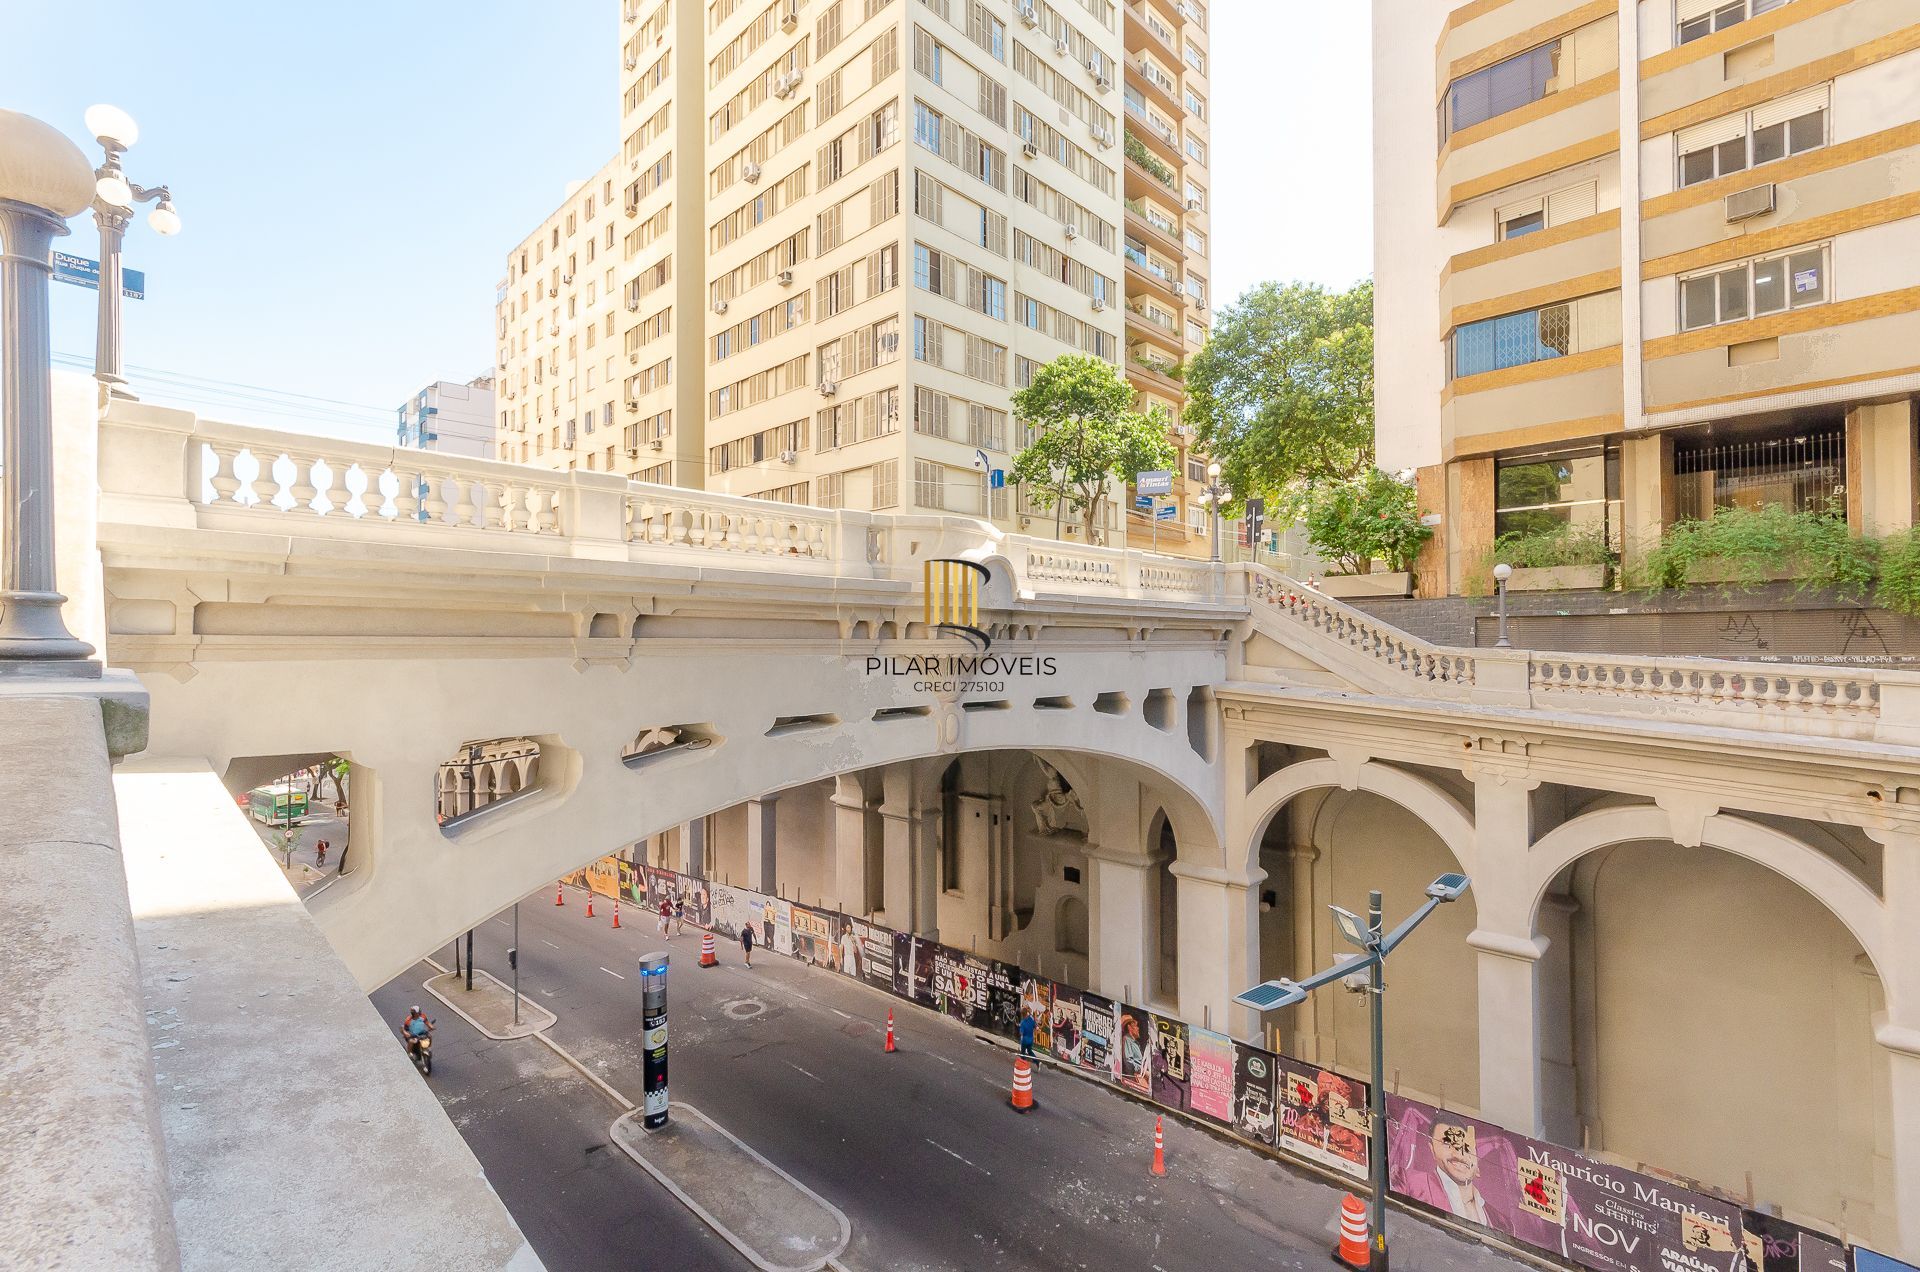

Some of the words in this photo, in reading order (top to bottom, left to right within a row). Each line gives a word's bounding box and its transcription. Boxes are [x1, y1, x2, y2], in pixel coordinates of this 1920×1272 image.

[55, 252, 90, 267] Duque
[69, 263, 91, 273] Duque
[959, 963, 987, 978] AJUSTAR
[935, 975, 987, 1007] SADE
[969, 973, 1024, 995] DOENTE
[977, 981, 987, 991] DE
[1084, 1008, 1114, 1030] MICHAEL
[1527, 1146, 1626, 1194] Maurício
[1633, 1182, 1730, 1231] Manieri
[1527, 1200, 1557, 1217] RENDE
[1594, 1203, 1629, 1224] SUPER
[1605, 1199, 1645, 1220] Classics
[1573, 1213, 1640, 1254] NOV
[1572, 1243, 1614, 1264] INGRESSOS
[1615, 1260, 1627, 1269] EM
